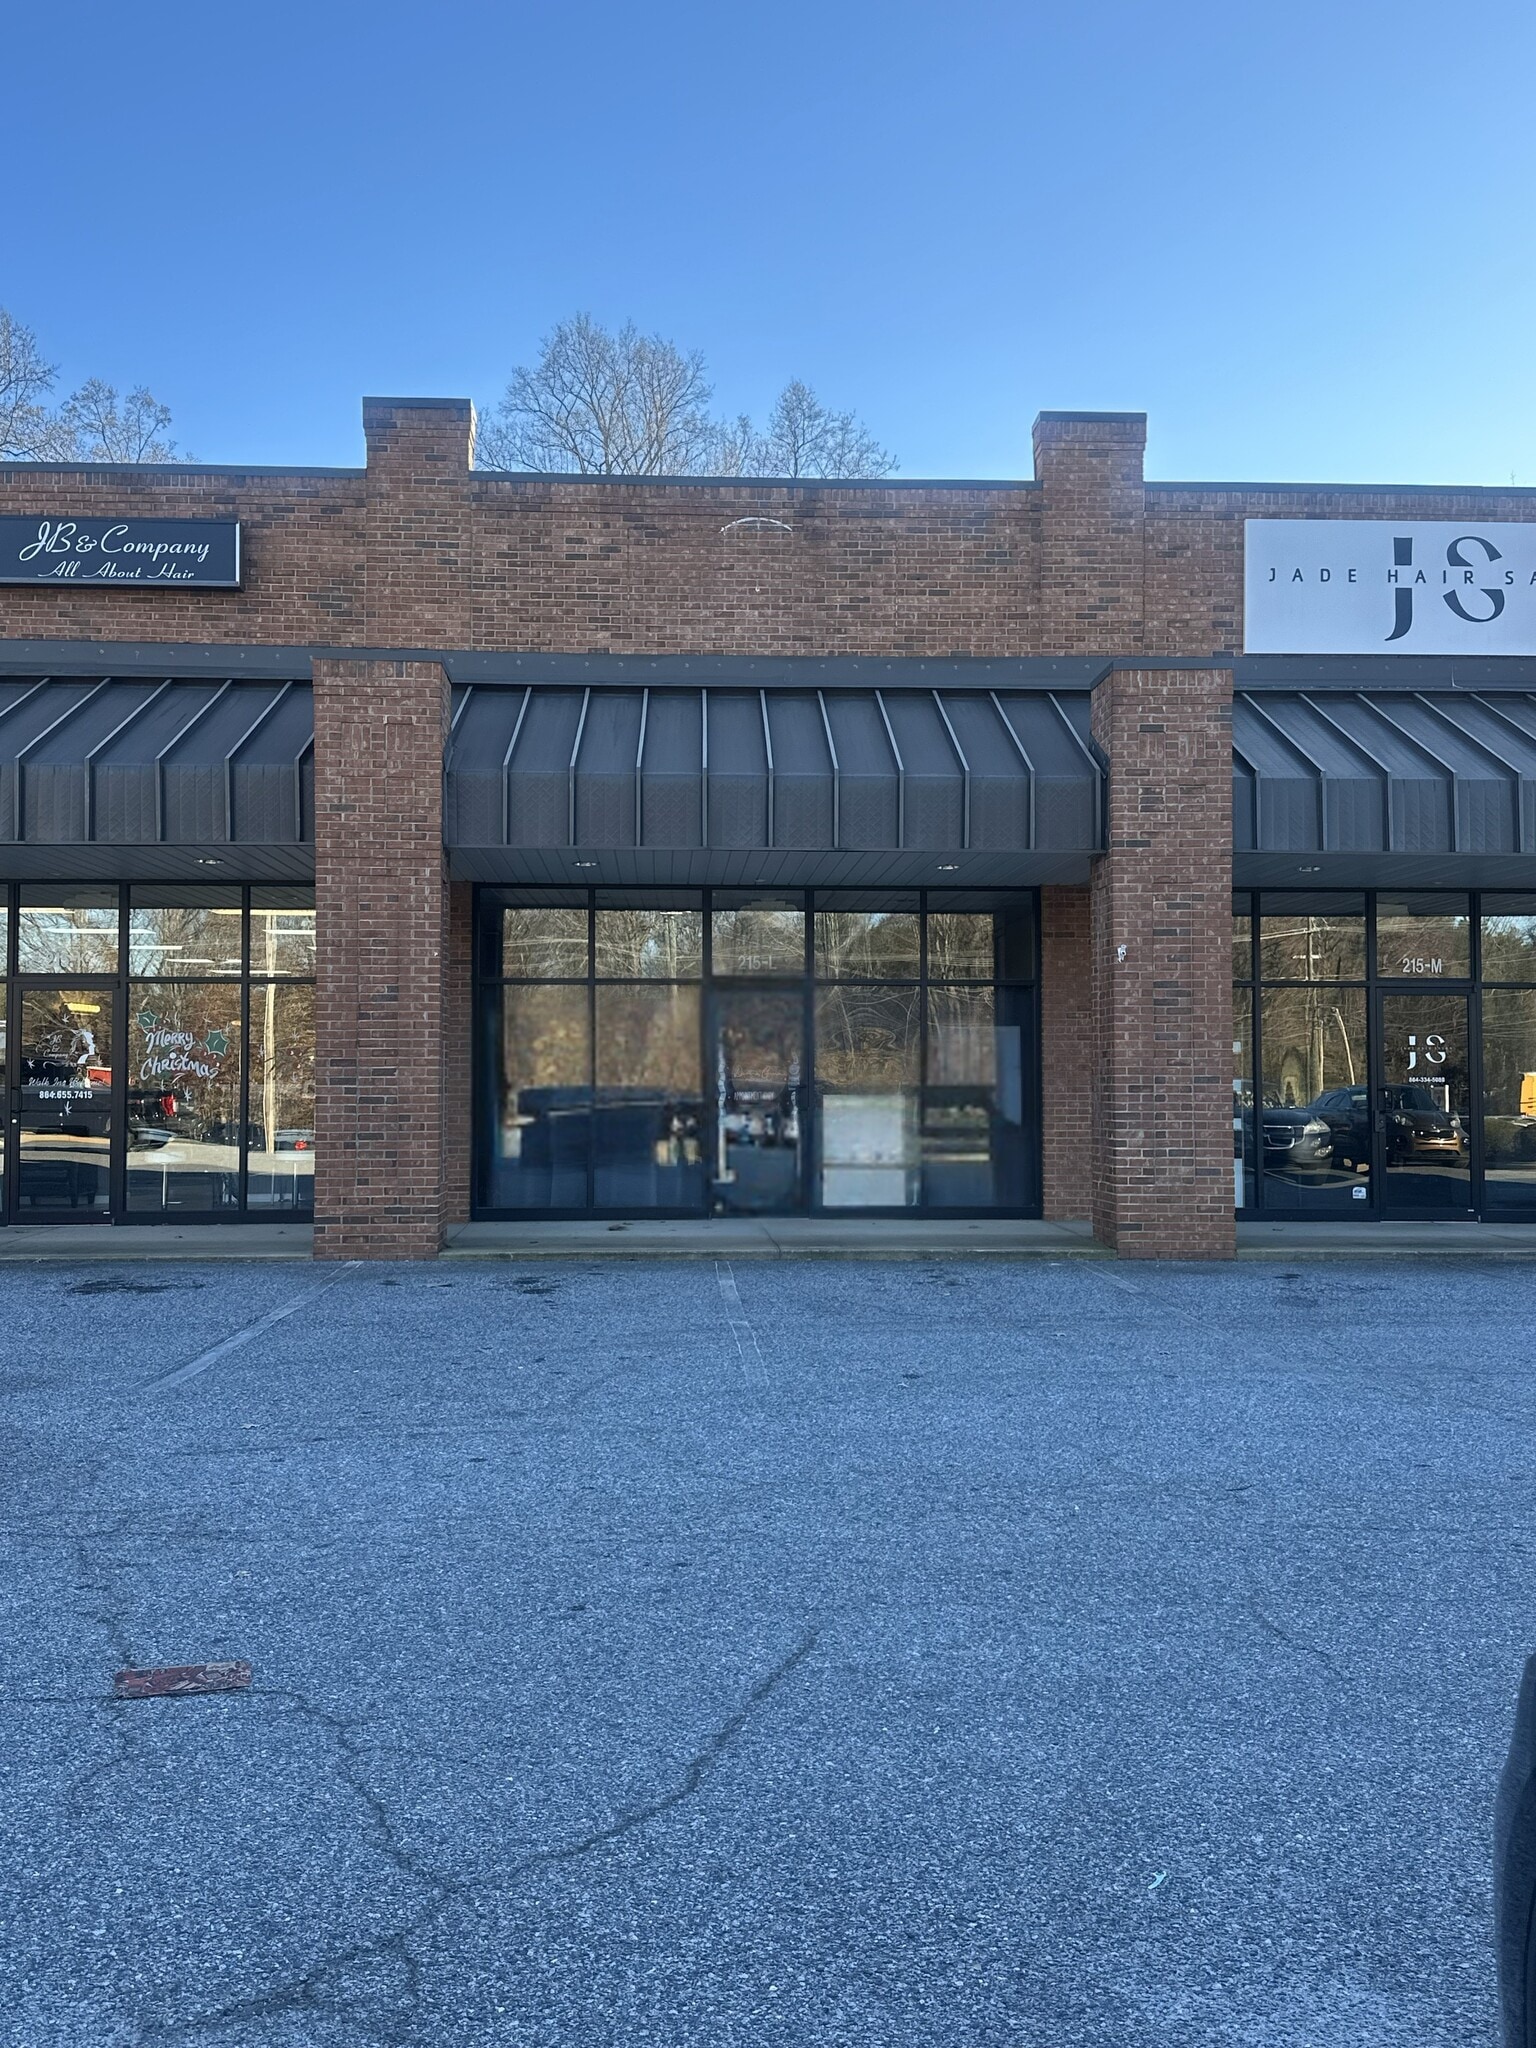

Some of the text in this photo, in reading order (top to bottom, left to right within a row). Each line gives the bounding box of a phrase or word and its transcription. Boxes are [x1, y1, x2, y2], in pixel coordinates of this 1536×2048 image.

[19, 521, 210, 563] JB & Company
[38, 560, 195, 580] All About Hair
[1269, 567, 1357, 583] JADE
[1387, 569, 1474, 585] HAIR
[738, 955, 777, 970] 215-L
[1402, 958, 1442, 973] 215-M
